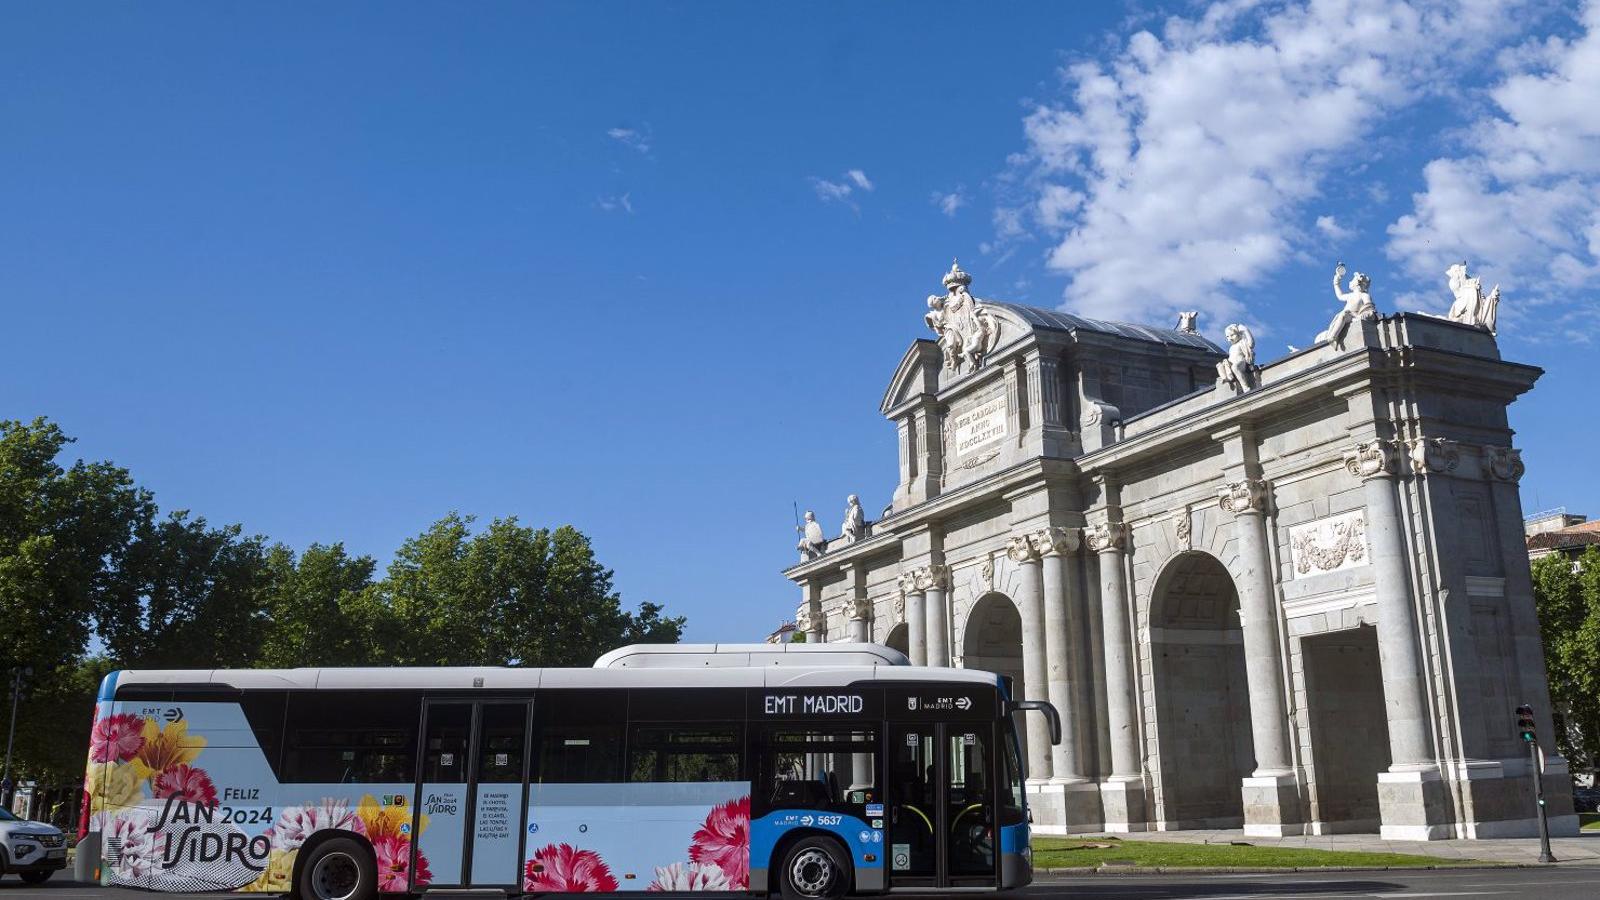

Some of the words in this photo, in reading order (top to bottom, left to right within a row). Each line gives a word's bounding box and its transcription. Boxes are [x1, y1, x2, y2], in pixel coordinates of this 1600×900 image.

[765, 696, 797, 714] EMT
[803, 695, 863, 713] MADRID
[224, 788, 259, 800] FELIZ
[424, 793, 442, 806] SAN
[147, 790, 214, 832] SAN
[221, 806, 273, 824] 2024
[817, 815, 842, 825] 5637
